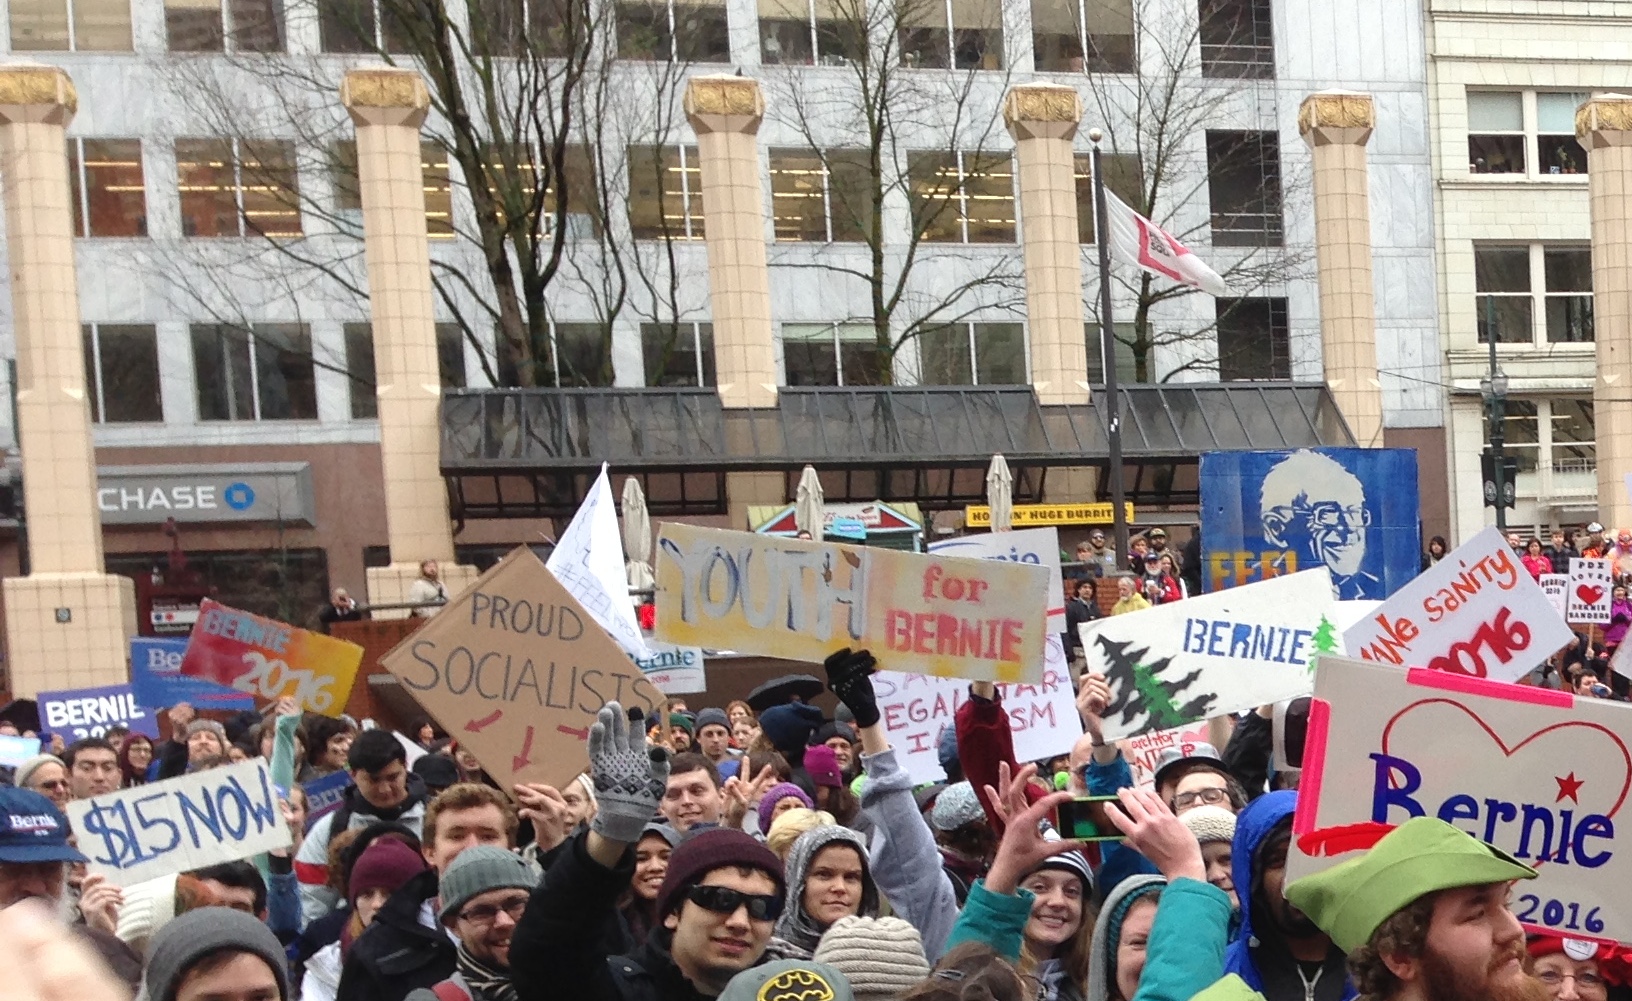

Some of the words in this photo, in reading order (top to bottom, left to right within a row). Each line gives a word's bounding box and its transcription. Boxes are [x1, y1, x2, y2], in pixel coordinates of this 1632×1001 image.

[97, 485, 218, 512] CHASE
[1030, 509, 1063, 520] HUGE
[659, 537, 868, 641] YOUTH
[923, 562, 988, 604] for
[202, 609, 291, 653] BERNIE
[471, 591, 584, 642] PROUD
[884, 608, 1024, 662] BERNIE
[1184, 616, 1314, 668] BERNIE
[232, 651, 336, 712] 2016
[402, 639, 654, 716] SOCIALISTS
[83, 800, 181, 870] $15
[174, 764, 276, 849] NOW
[1369, 753, 1615, 868] Bernie
[1518, 894, 1604, 934] 2016
